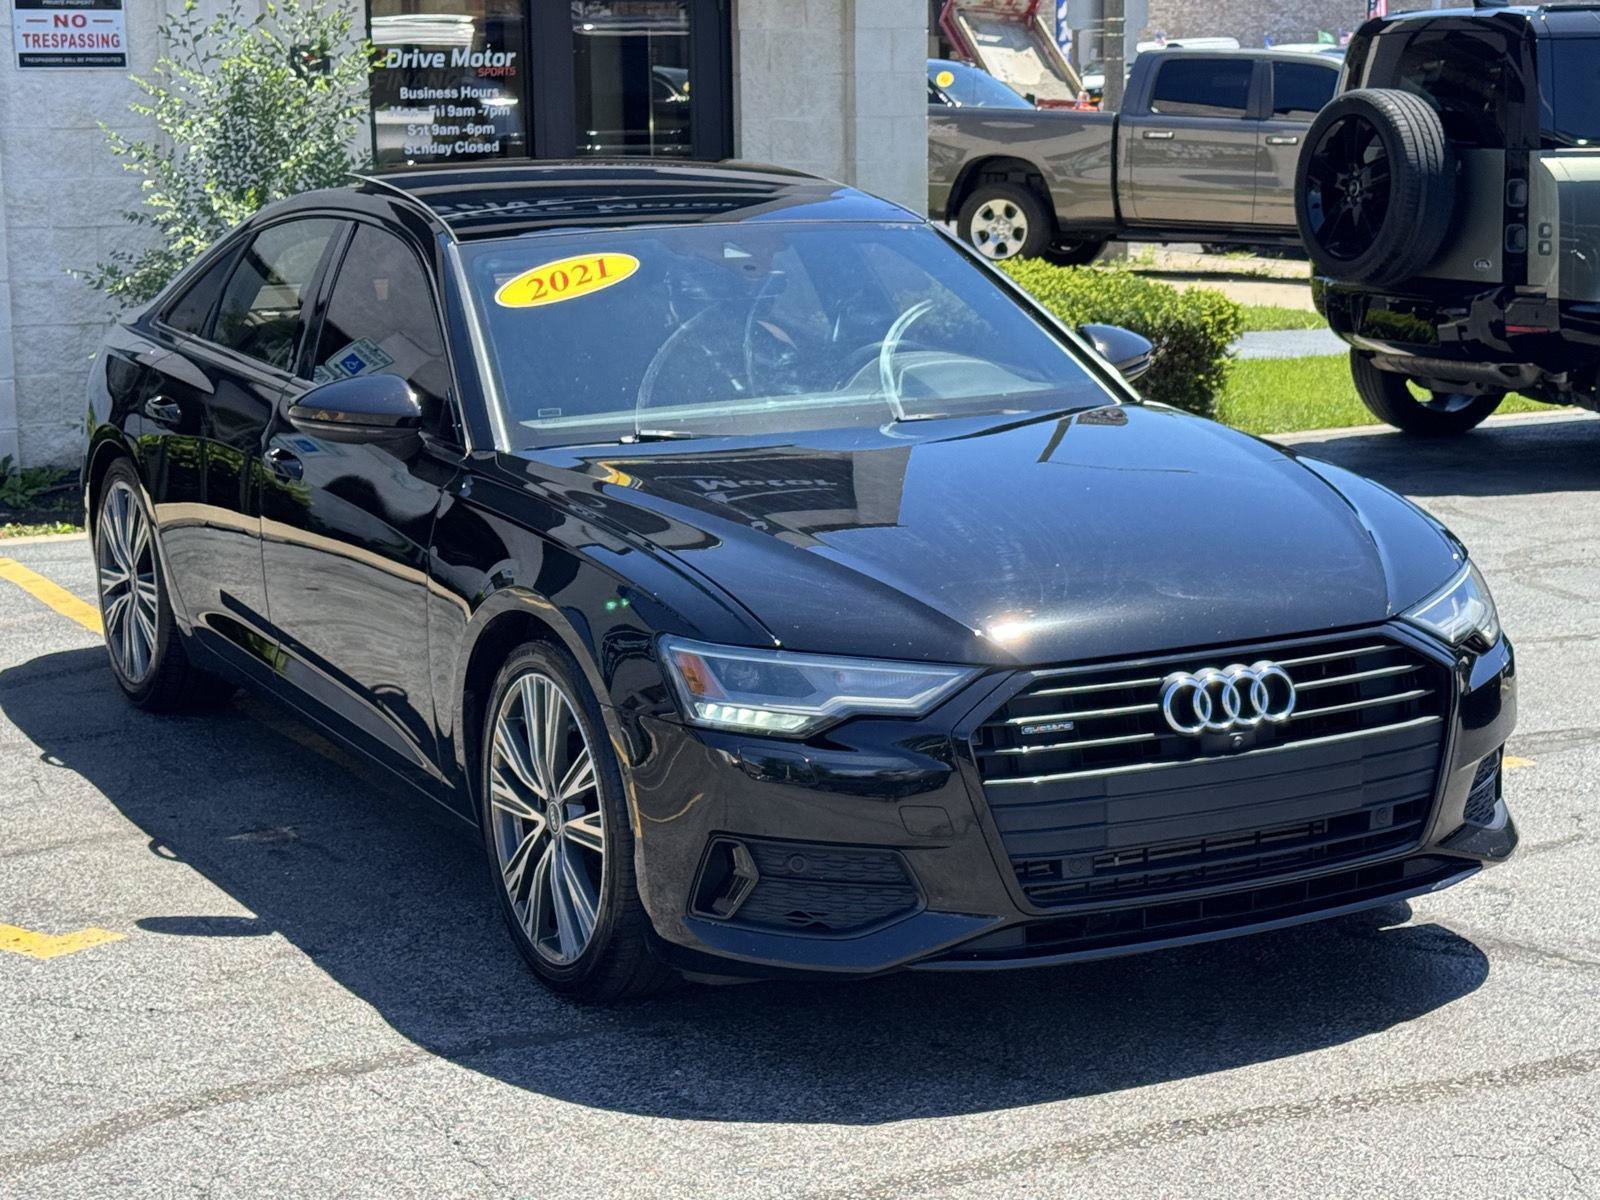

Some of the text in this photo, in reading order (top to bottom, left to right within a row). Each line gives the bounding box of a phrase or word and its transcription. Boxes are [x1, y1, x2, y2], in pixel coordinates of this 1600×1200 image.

[53, 14, 87, 28] NO
[22, 33, 121, 49] TRESPASSING
[386, 47, 517, 69] Drive Motor
[478, 67, 517, 77] SPORTS
[400, 86, 499, 100] Business Hours
[447, 104, 476, 117] 9am
[431, 123, 460, 136] 9am
[404, 140, 499, 157] Sunday Closed
[526, 258, 612, 301] 2021
